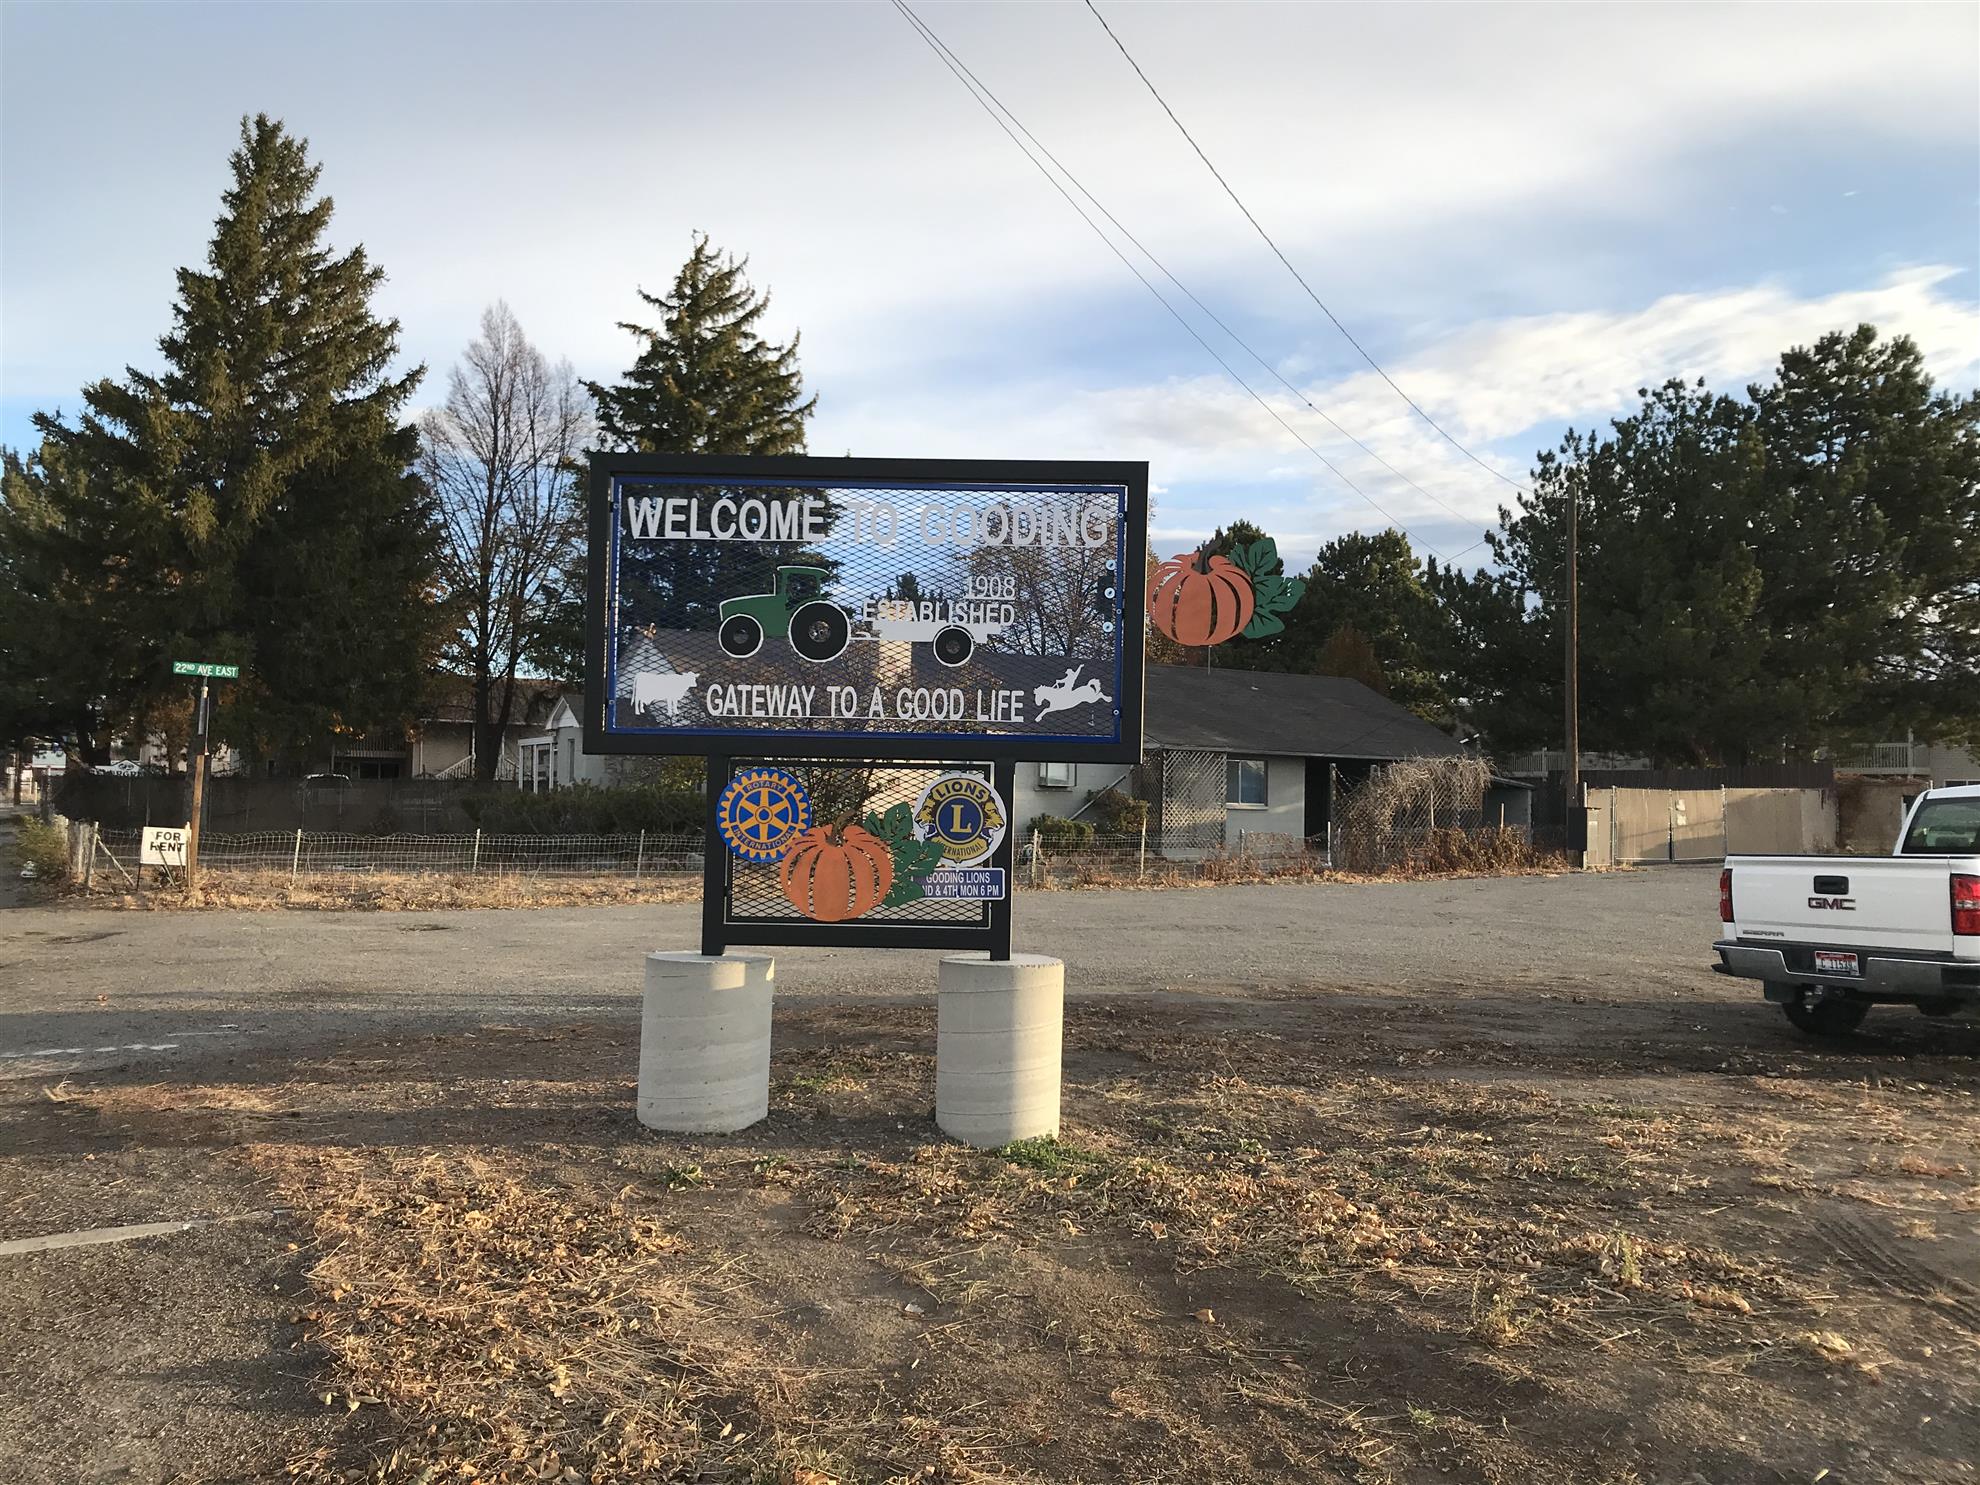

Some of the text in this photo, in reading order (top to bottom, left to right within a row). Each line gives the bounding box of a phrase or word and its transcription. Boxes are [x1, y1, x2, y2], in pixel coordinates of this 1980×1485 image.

[627, 496, 1108, 547] WELCOME TO GOODING
[964, 575, 1016, 600] 1908
[862, 600, 1015, 626] ESTABLISHED
[197, 665, 213, 675] AVE
[215, 666, 236, 677] EAST
[706, 683, 1025, 722] GATEWAY TO A GOOD LIFE
[745, 780, 784, 791] ROTARY
[935, 781, 987, 800] LIONS
[950, 804, 972, 833] L
[155, 831, 182, 841] FOR
[733, 827, 795, 850] INTERNATIONAL
[150, 841, 185, 852] RENT
[944, 841, 984, 857] ERNATIONAL
[926, 871, 990, 883] GOODING LIONS
[935, 884, 941, 896] &
[943, 884, 958, 896] 4TH
[960, 885, 979, 896] MON
[980, 885, 986, 896] 6
[987, 885, 999, 897] PM
[1808, 897, 1856, 910] GMC
